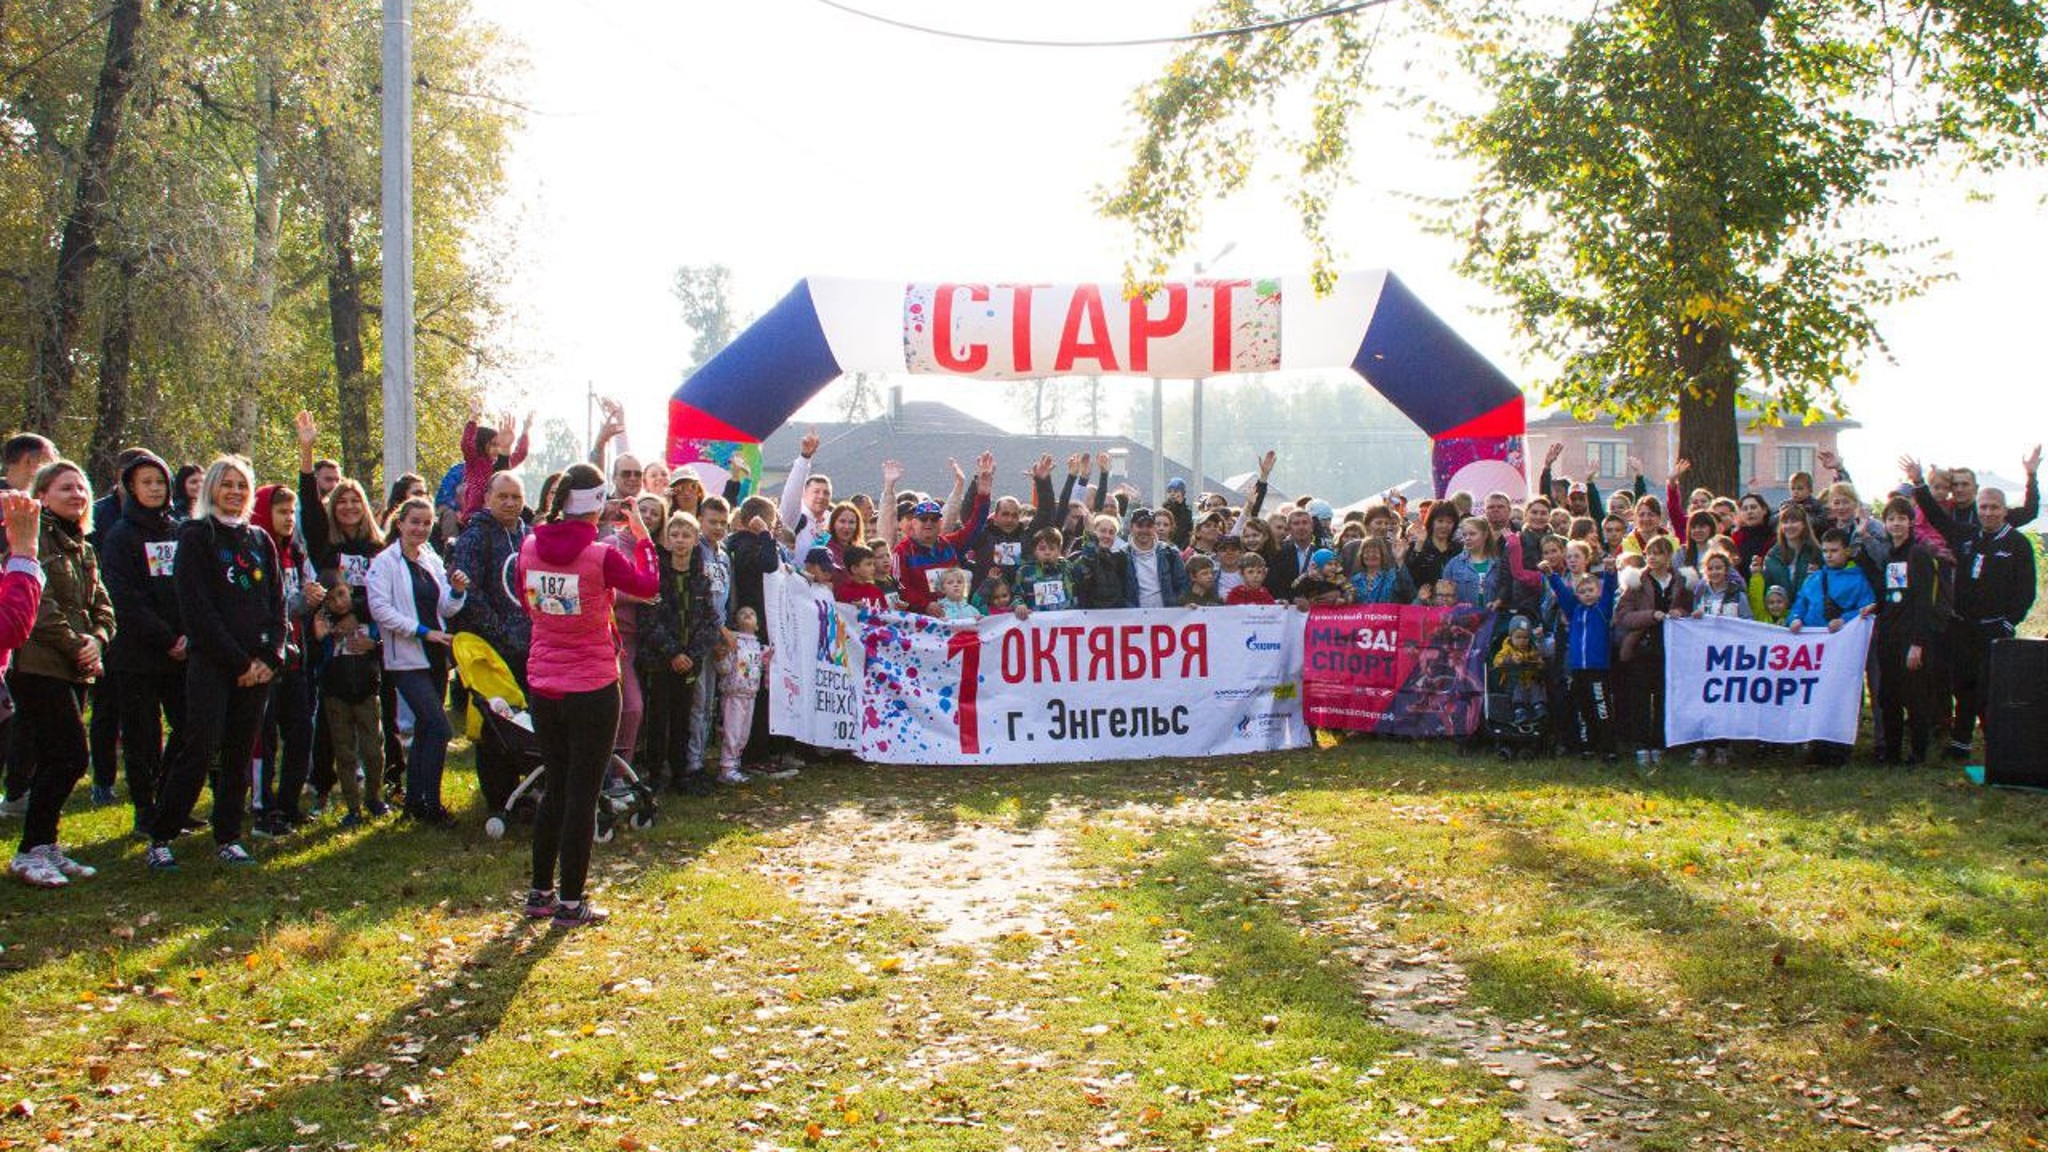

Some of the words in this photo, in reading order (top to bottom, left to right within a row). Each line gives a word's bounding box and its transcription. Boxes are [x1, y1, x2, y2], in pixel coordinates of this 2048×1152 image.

[932, 282, 1252, 373] СТАРТ
[540, 575, 566, 596] 187
[1312, 650, 1394, 677] СПОРТ
[947, 630, 981, 754] 1
[1001, 623, 1208, 684] ОКТЯБРЯ
[1702, 676, 1820, 706] СПОРТ
[1007, 711, 1034, 741] г.
[1047, 698, 1189, 740] Энгельс
